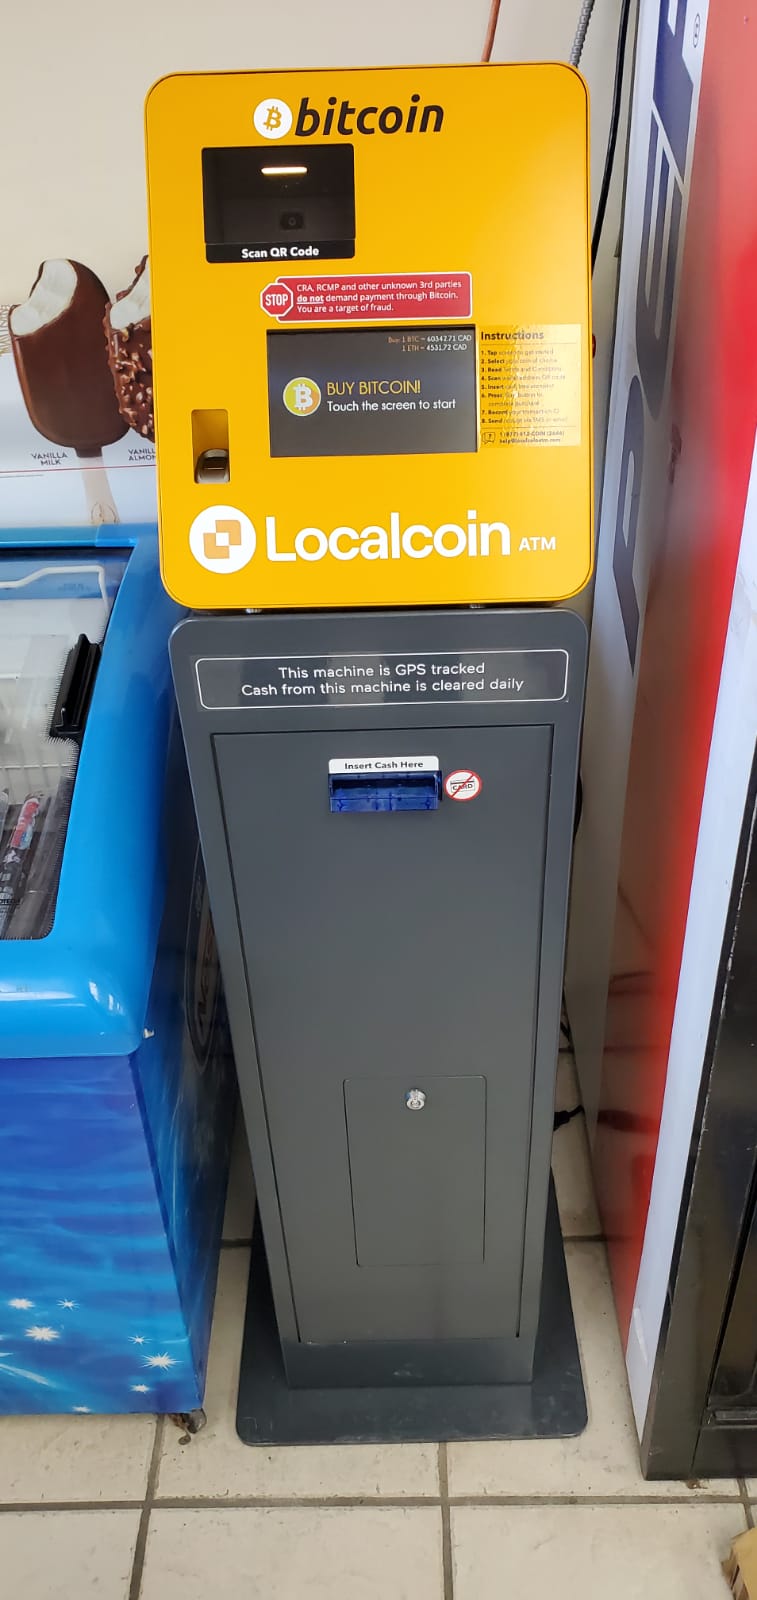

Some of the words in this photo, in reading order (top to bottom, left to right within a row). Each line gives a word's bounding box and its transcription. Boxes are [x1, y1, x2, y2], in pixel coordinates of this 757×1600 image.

[295, 94, 444, 137] bitcoin
[241, 247, 268, 259] Scan
[270, 246, 288, 259] QR
[290, 245, 320, 258] Code
[296, 284, 314, 292] CRA,
[316, 283, 340, 291] RCMP
[341, 282, 356, 291] and
[358, 282, 380, 290] other
[382, 281, 417, 290] unknown
[420, 280, 432, 289] 3rd
[435, 280, 461, 290] parties
[265, 294, 288, 306] STOP
[297, 294, 307, 303] do
[310, 294, 324, 303] not
[326, 293, 358, 302] demand
[360, 293, 394, 303] payment
[396, 292, 427, 302] through
[430, 291, 458, 299] Bitcoin.
[335, 305, 358, 314] target
[360, 304, 369, 312] of
[370, 303, 394, 312] fraud.
[481, 330, 544, 340] Instructions
[327, 382, 354, 396] BUY
[359, 380, 421, 395] BITCOIN!
[327, 401, 359, 412] Touch
[362, 400, 379, 411] the
[381, 402, 416, 410] screen
[418, 400, 430, 410] to
[433, 399, 456, 410] start
[265, 510, 510, 562] Localcoin
[518, 536, 556, 552] ATM
[278, 666, 308, 679] This
[313, 665, 374, 678] machine
[379, 664, 391, 676] is
[395, 664, 426, 677] GPS
[431, 662, 486, 675] tracked
[242, 683, 277, 696] Cash
[281, 682, 315, 695] from
[320, 681, 346, 694] this
[350, 680, 411, 693] machine
[415, 679, 427, 692] is
[432, 678, 485, 691] cleared
[489, 677, 524, 692] daily
